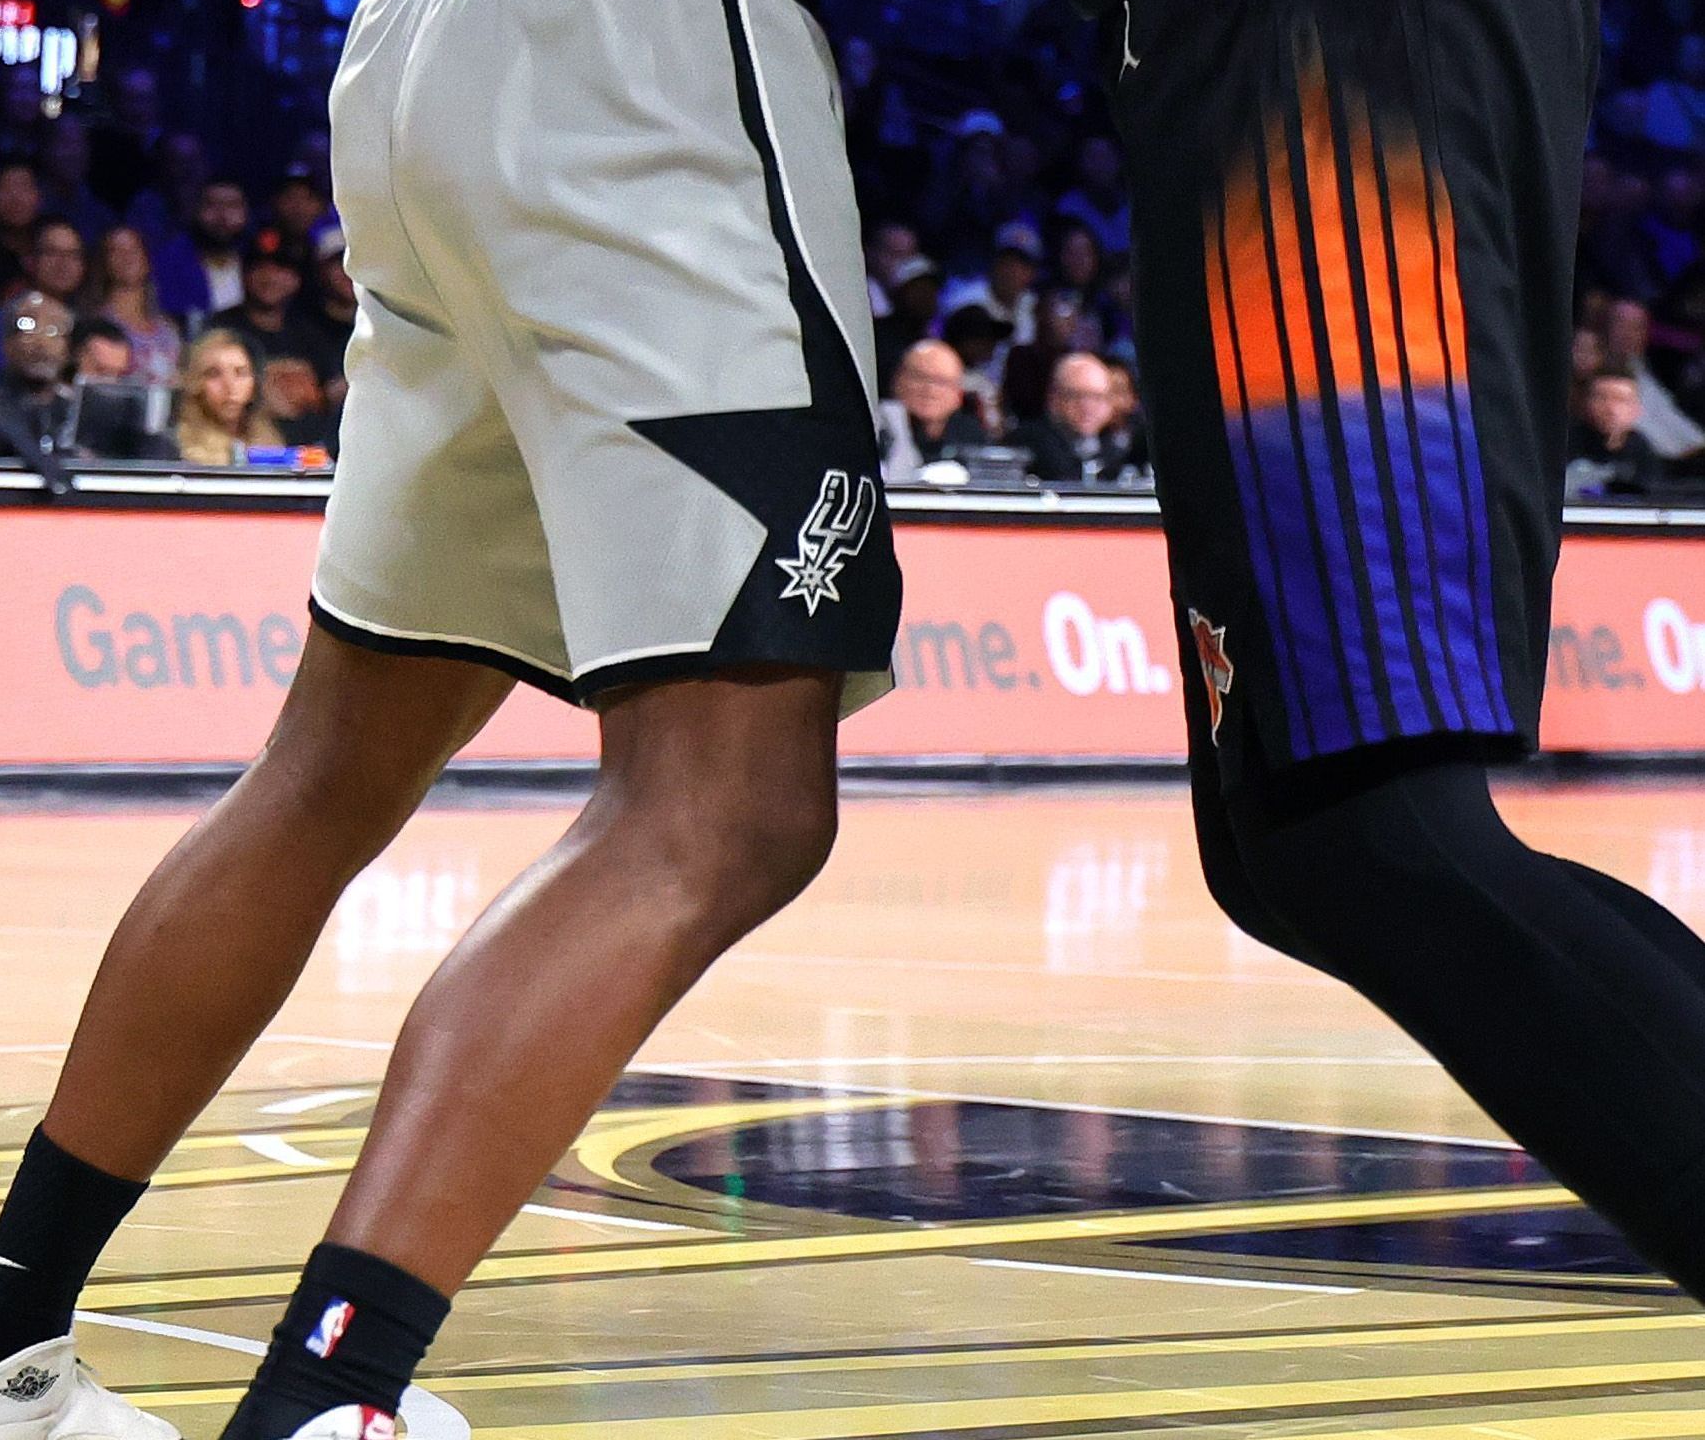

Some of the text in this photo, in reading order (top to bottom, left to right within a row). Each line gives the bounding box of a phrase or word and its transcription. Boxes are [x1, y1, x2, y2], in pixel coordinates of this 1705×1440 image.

[54, 585, 301, 689] Game
[891, 590, 1172, 697] me. On.
